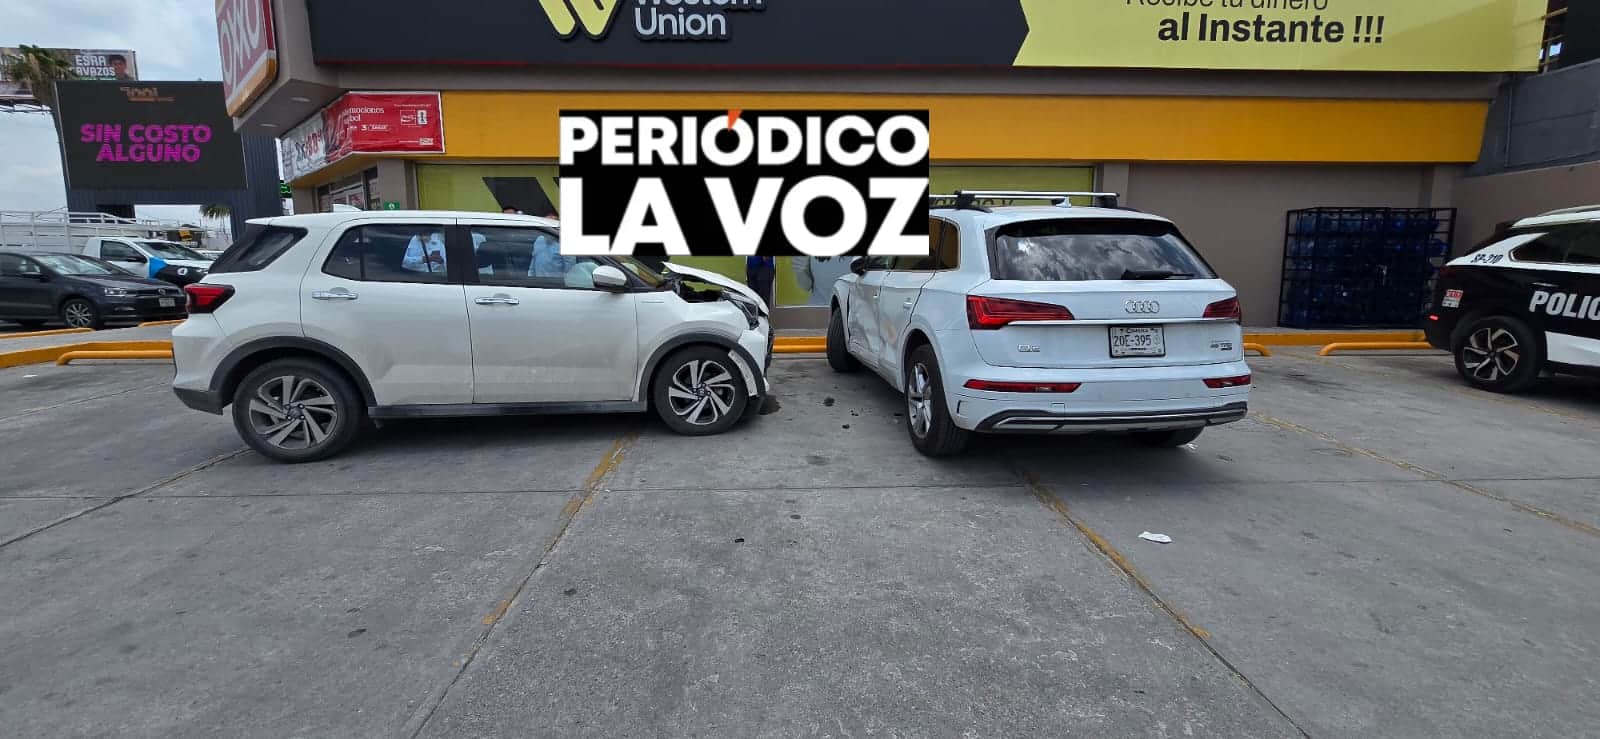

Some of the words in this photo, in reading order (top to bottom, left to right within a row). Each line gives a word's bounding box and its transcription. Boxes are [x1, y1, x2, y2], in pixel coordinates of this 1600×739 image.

[634, 7, 726, 36] Union
[1158, 11, 1190, 41] al
[1198, 13, 1345, 43] Instante
[1353, 15, 1385, 43] !!!
[80, 124, 122, 144] SIN
[128, 124, 213, 144] COSTO
[96, 143, 201, 163] ALGUNO
